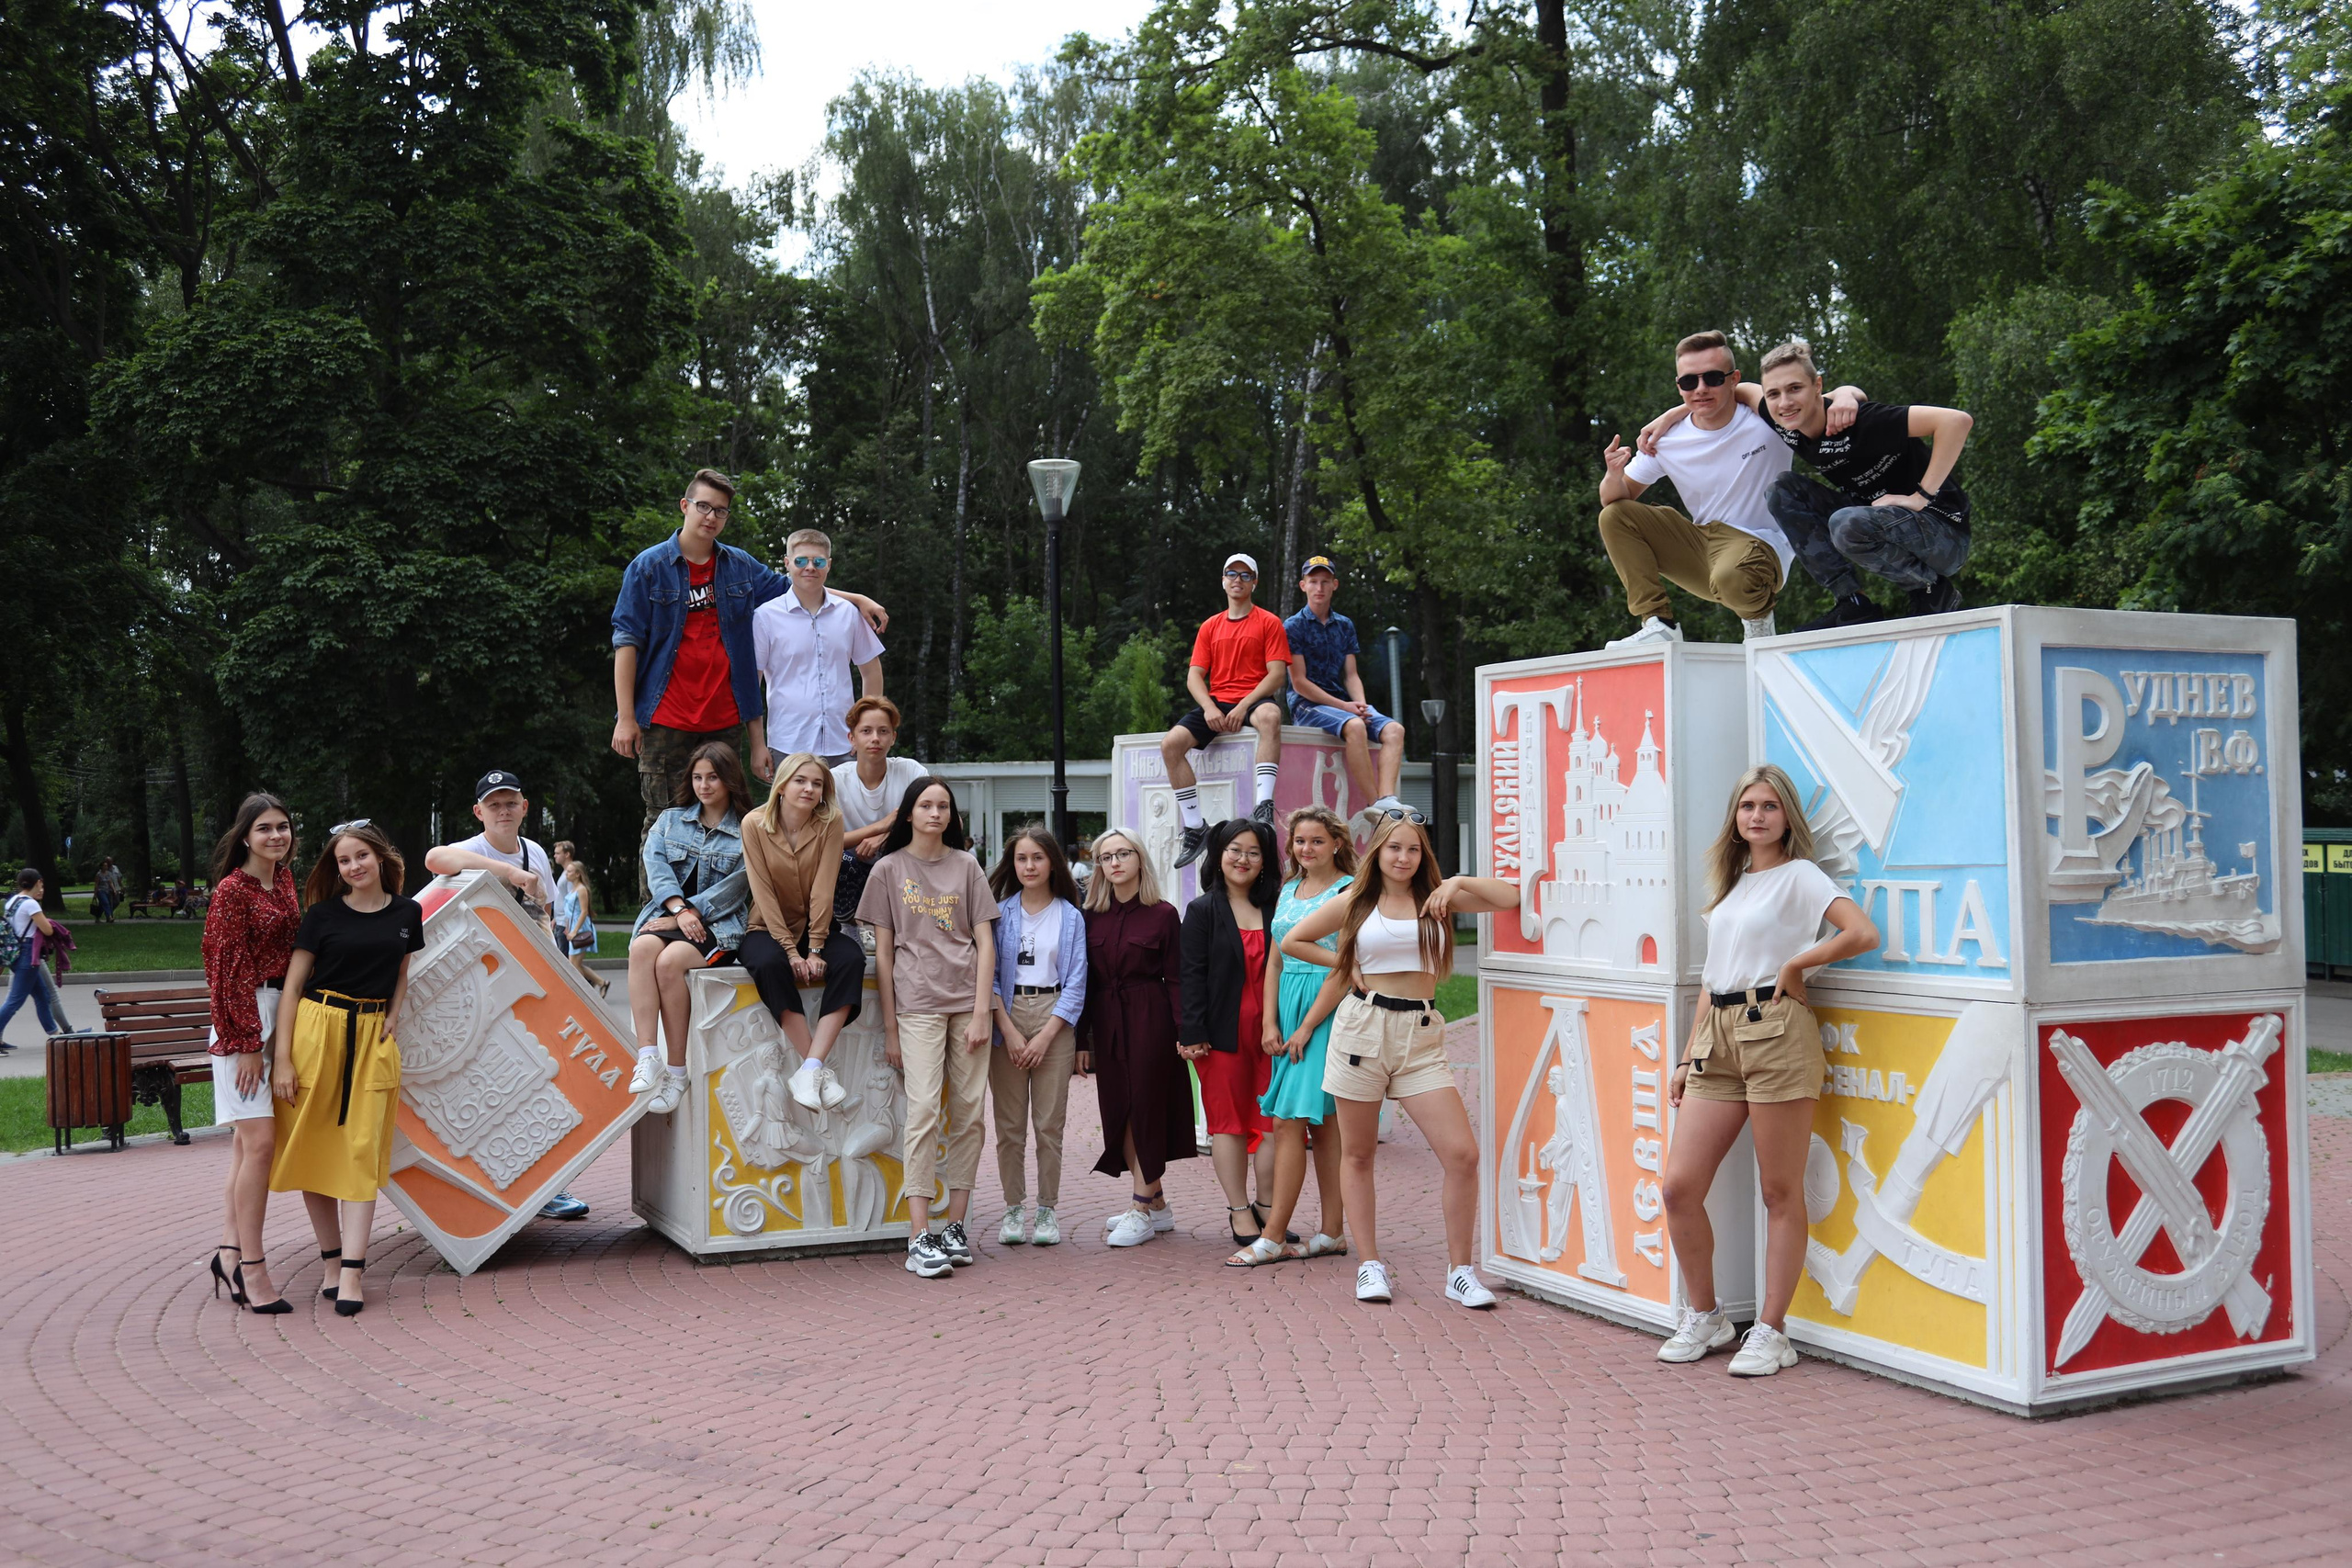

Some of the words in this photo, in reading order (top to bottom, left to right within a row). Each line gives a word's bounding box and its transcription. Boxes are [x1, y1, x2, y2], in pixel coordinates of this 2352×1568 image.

[1742, 445, 1767, 459] OFF-WHITE
[2197, 728, 2264, 775] В.Ф.
[902, 895, 920, 905] YOU
[938, 896, 959, 905] JUST
[928, 907, 953, 916] FUNNY
[558, 1015, 625, 1091] ТУЛА
[2146, 1066, 2194, 1097] 1712
[1631, 1020, 1663, 1268] ЛЕВША
